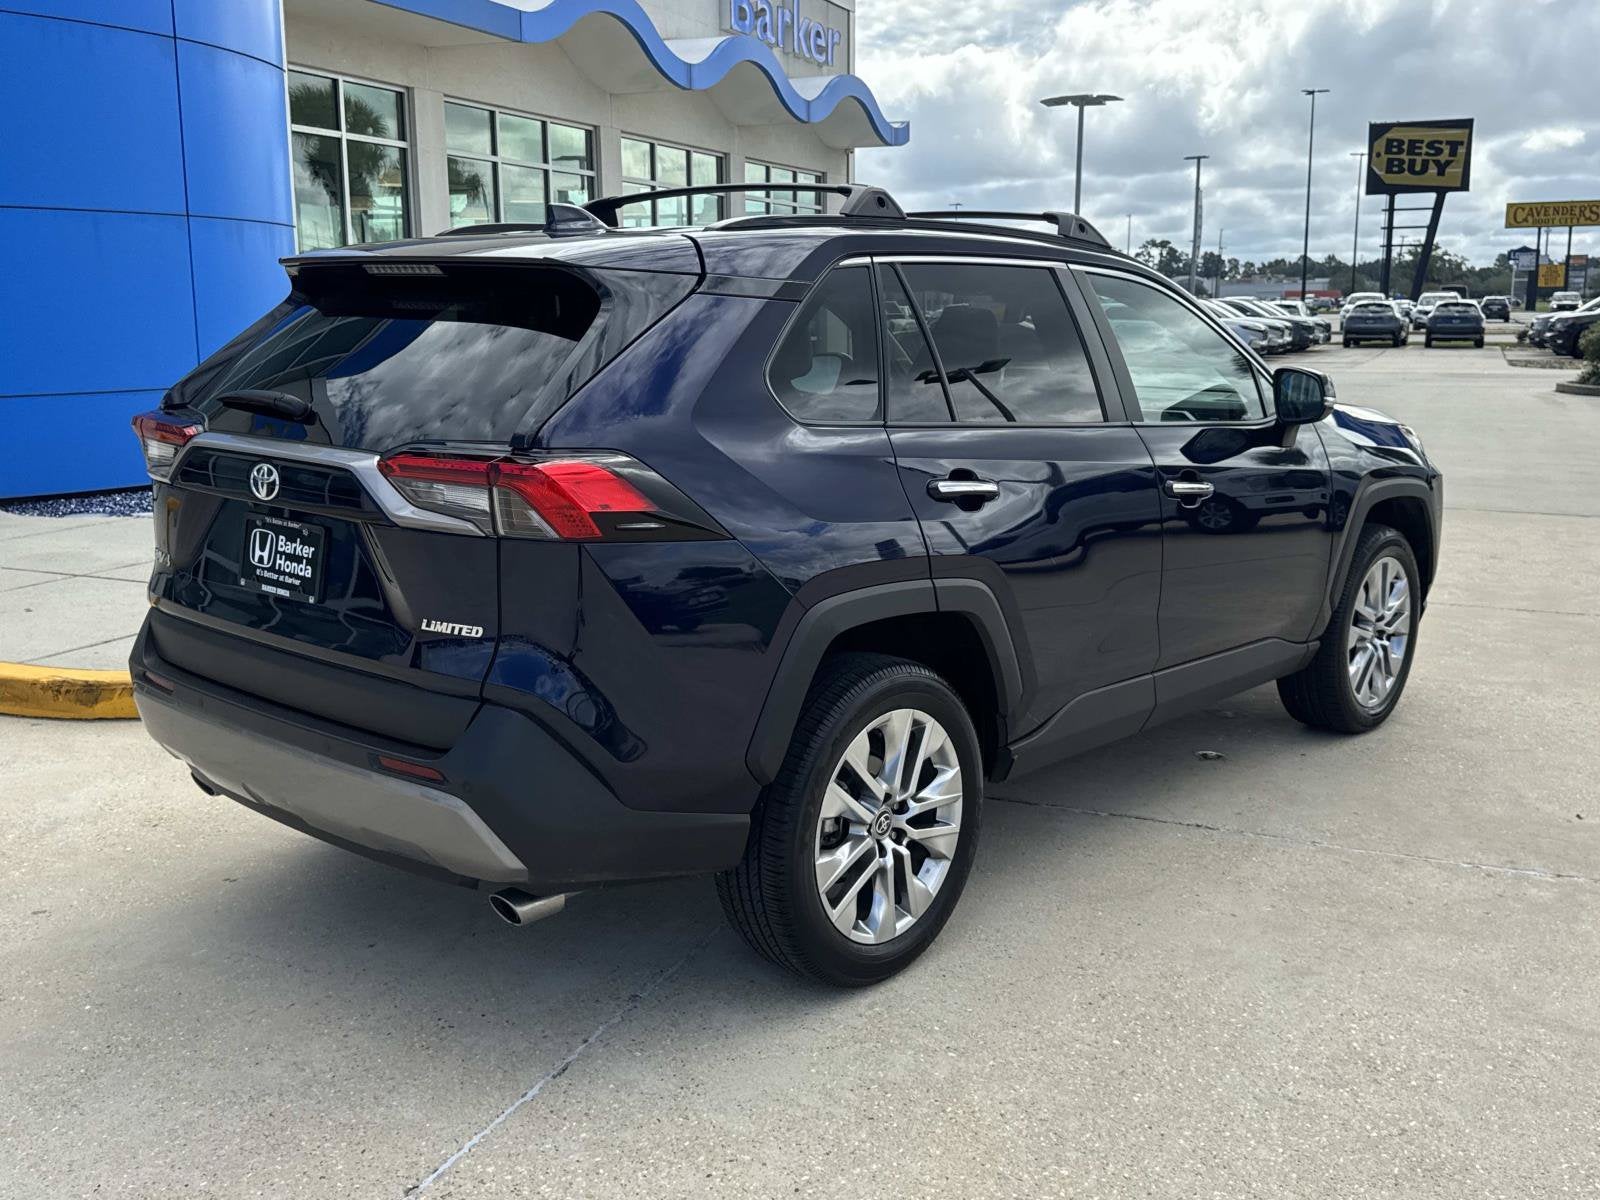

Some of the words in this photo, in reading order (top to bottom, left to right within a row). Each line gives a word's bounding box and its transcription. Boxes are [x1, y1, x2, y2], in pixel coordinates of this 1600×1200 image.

[1384, 138, 1464, 157] BEST
[1385, 158, 1454, 176] BUY
[1512, 204, 1600, 224] CAVENDER'S
[277, 535, 315, 559] Barker
[263, 570, 279, 580] Better
[275, 553, 312, 578] Honda
